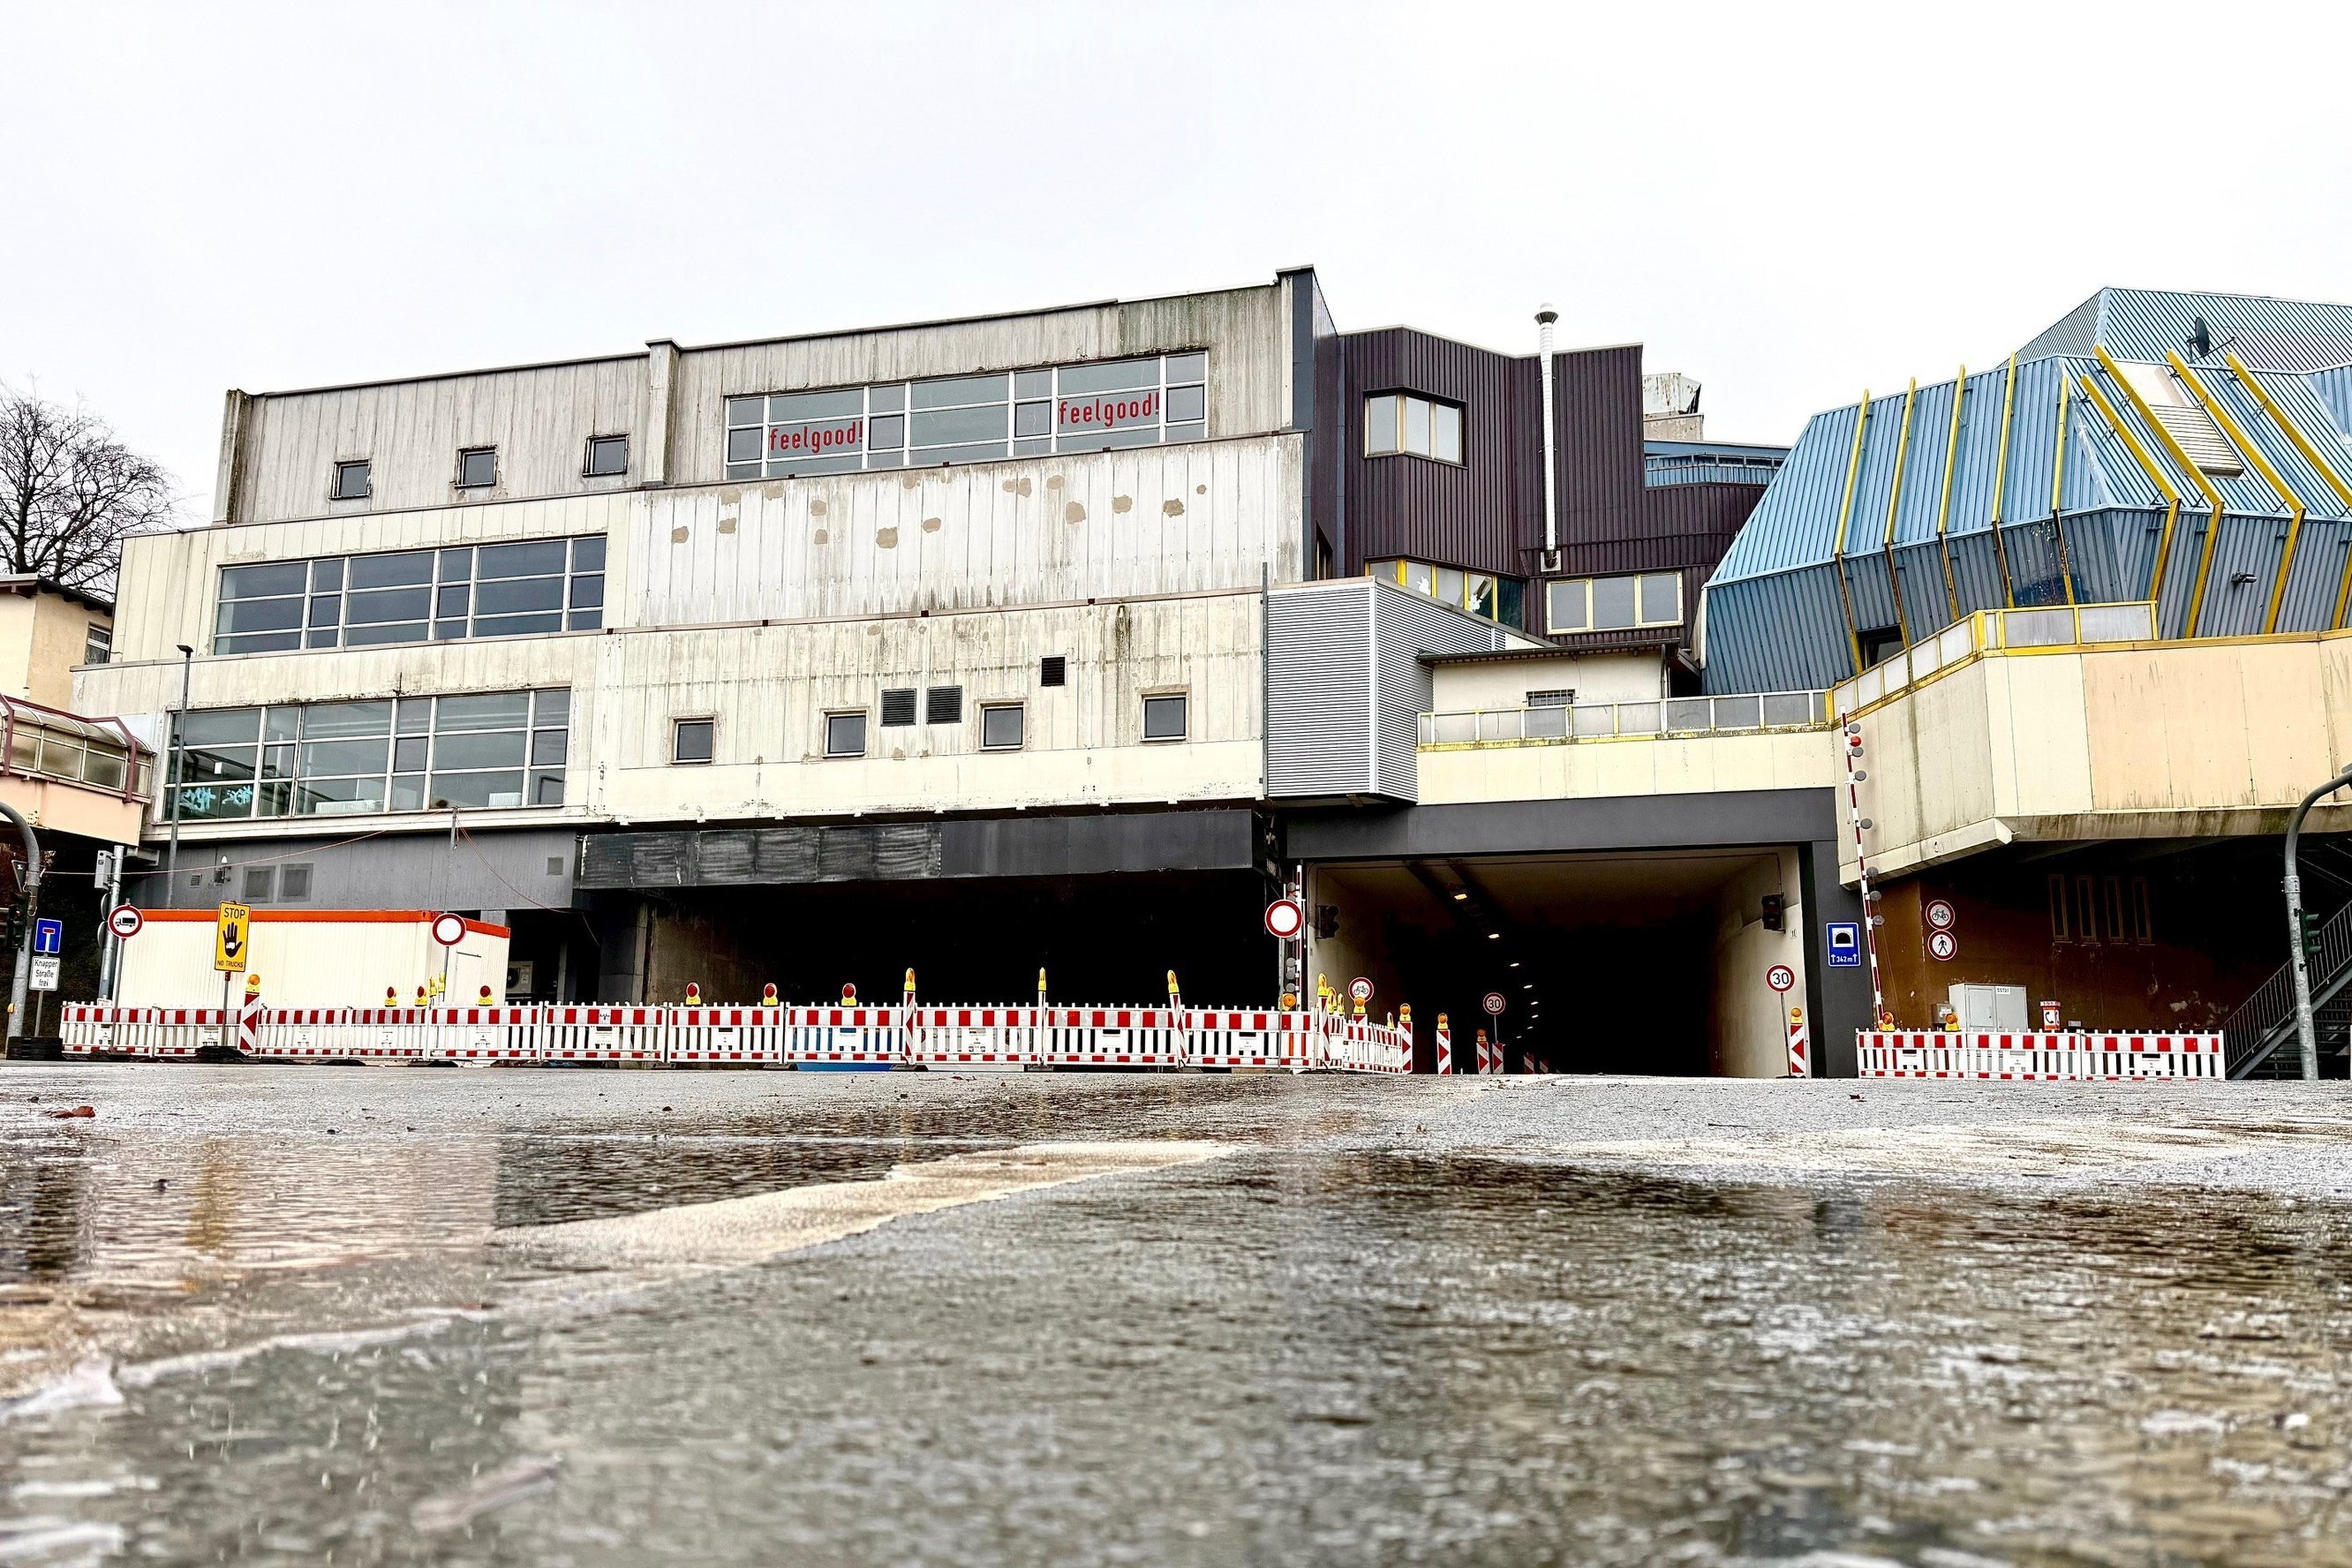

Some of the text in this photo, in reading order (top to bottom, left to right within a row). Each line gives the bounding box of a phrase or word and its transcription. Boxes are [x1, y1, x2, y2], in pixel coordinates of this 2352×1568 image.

[1059, 392, 1159, 426] feelgood!
[770, 421, 863, 453] feelgood!
[224, 908, 245, 919] STOP
[34, 960, 57, 969] Knapper
[35, 969, 54, 978] Straße
[1773, 972, 1790, 984] 30
[1488, 999, 1501, 1009] 30
